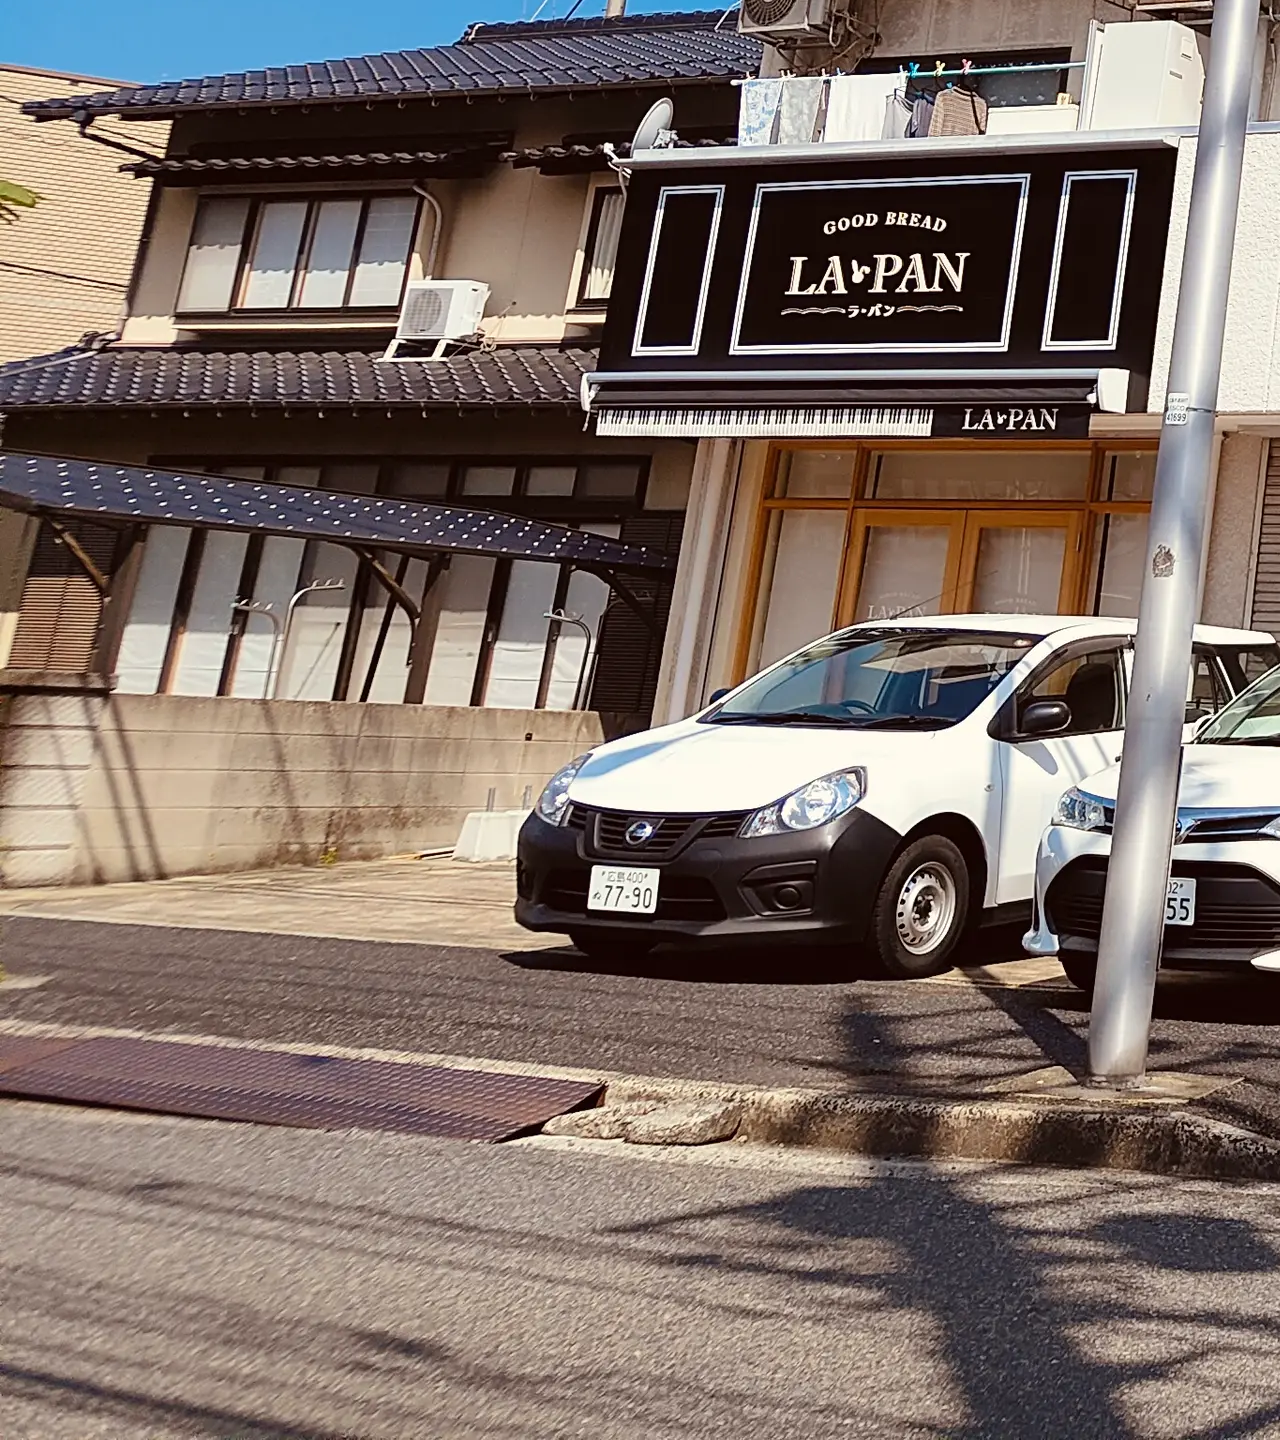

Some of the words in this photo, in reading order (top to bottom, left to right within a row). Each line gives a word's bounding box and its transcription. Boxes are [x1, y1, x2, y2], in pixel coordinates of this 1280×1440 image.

[823, 213, 878, 235] GOOD
[885, 211, 947, 232] BREAD
[848, 303, 895, 318] ラ・パン
[603, 884, 653, 908] 77-90
